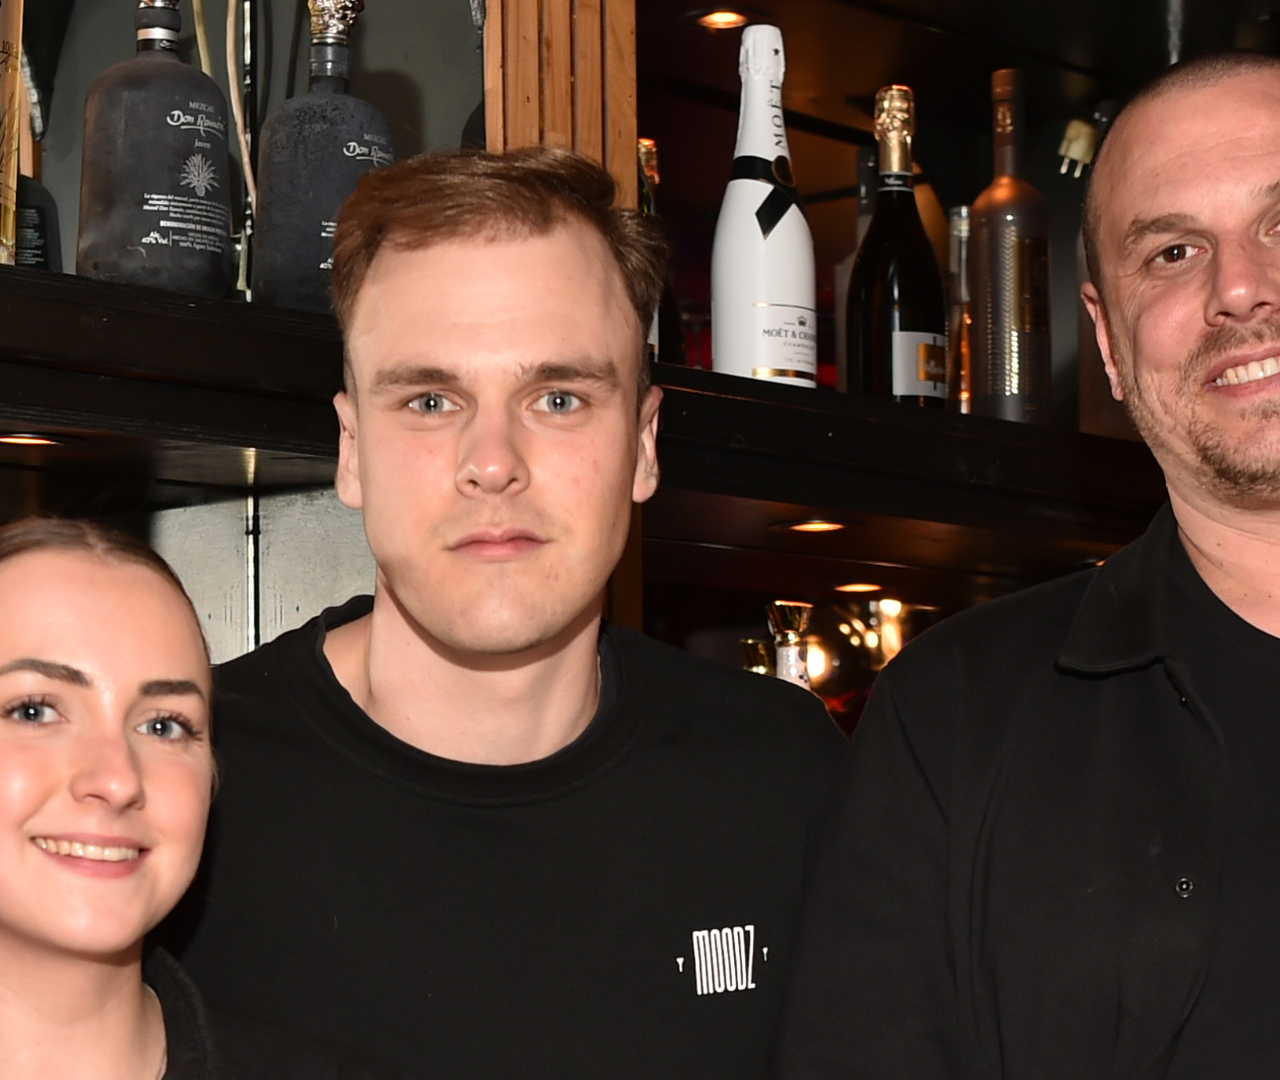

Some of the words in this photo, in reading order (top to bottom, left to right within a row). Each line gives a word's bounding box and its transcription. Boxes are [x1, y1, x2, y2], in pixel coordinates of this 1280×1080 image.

[166, 110, 195, 126] Don
[767, 79, 787, 149] MOËT
[343, 142, 369, 157] Don
[762, 327, 789, 338] MOËT
[692, 925, 756, 995] MOODZ
